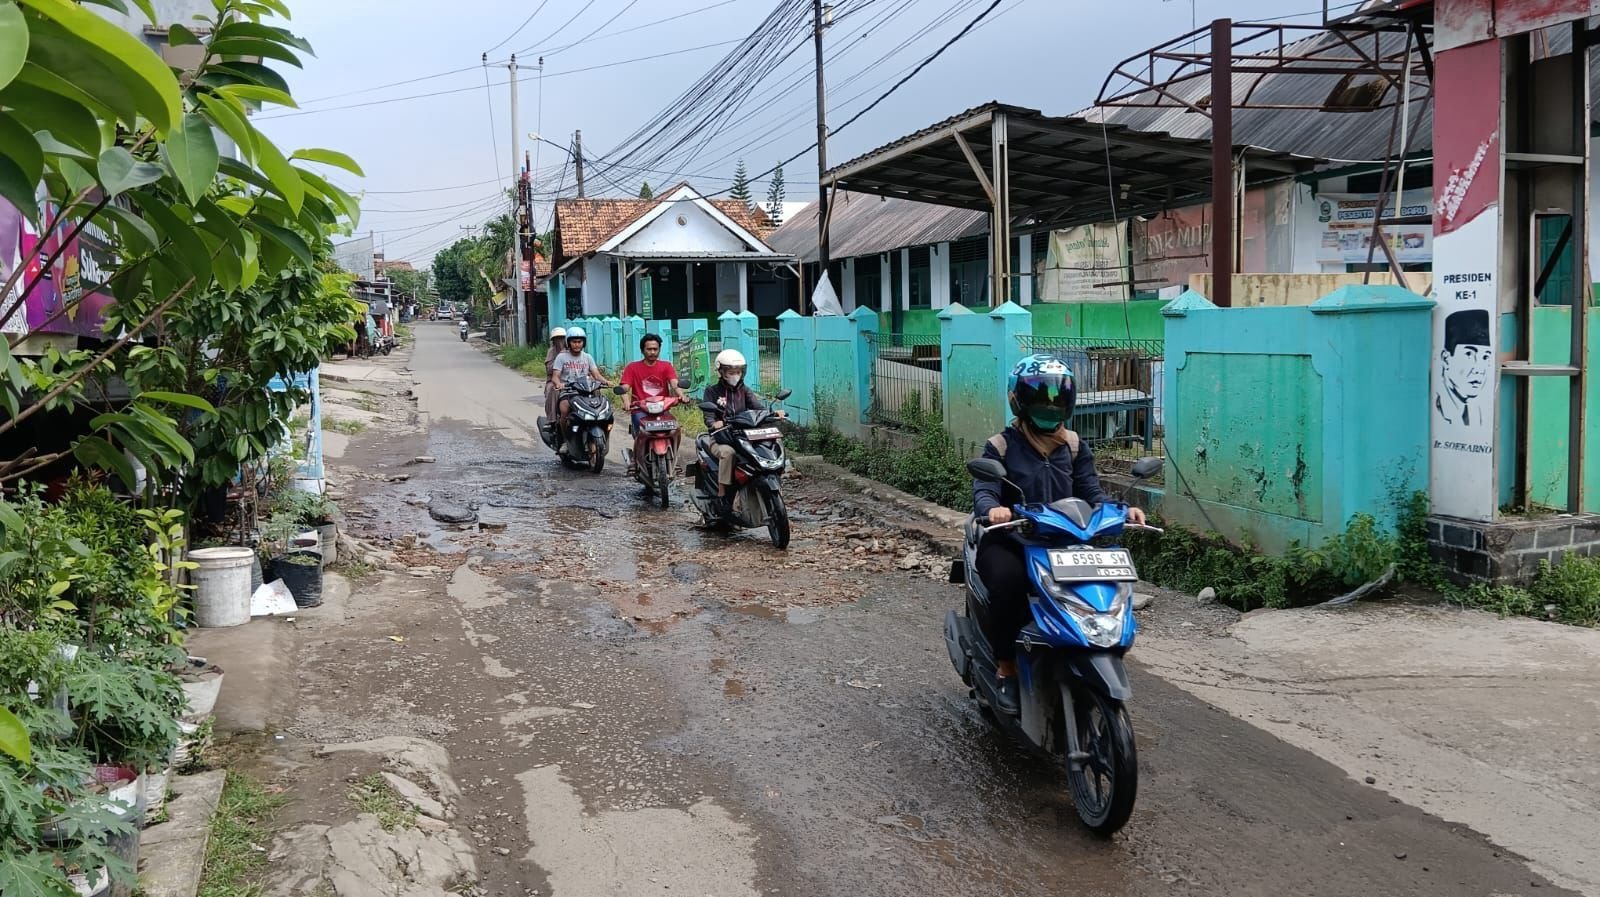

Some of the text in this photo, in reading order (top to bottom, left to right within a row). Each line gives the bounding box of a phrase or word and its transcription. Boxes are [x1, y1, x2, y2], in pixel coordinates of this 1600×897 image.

[1401, 206, 1427, 216] BARU
[1443, 273, 1492, 284] PRESIDEN
[1455, 290, 1477, 300] KE-1
[1444, 441, 1492, 453] SOEKARNO
[1056, 553, 1127, 565] A 6596 SW
